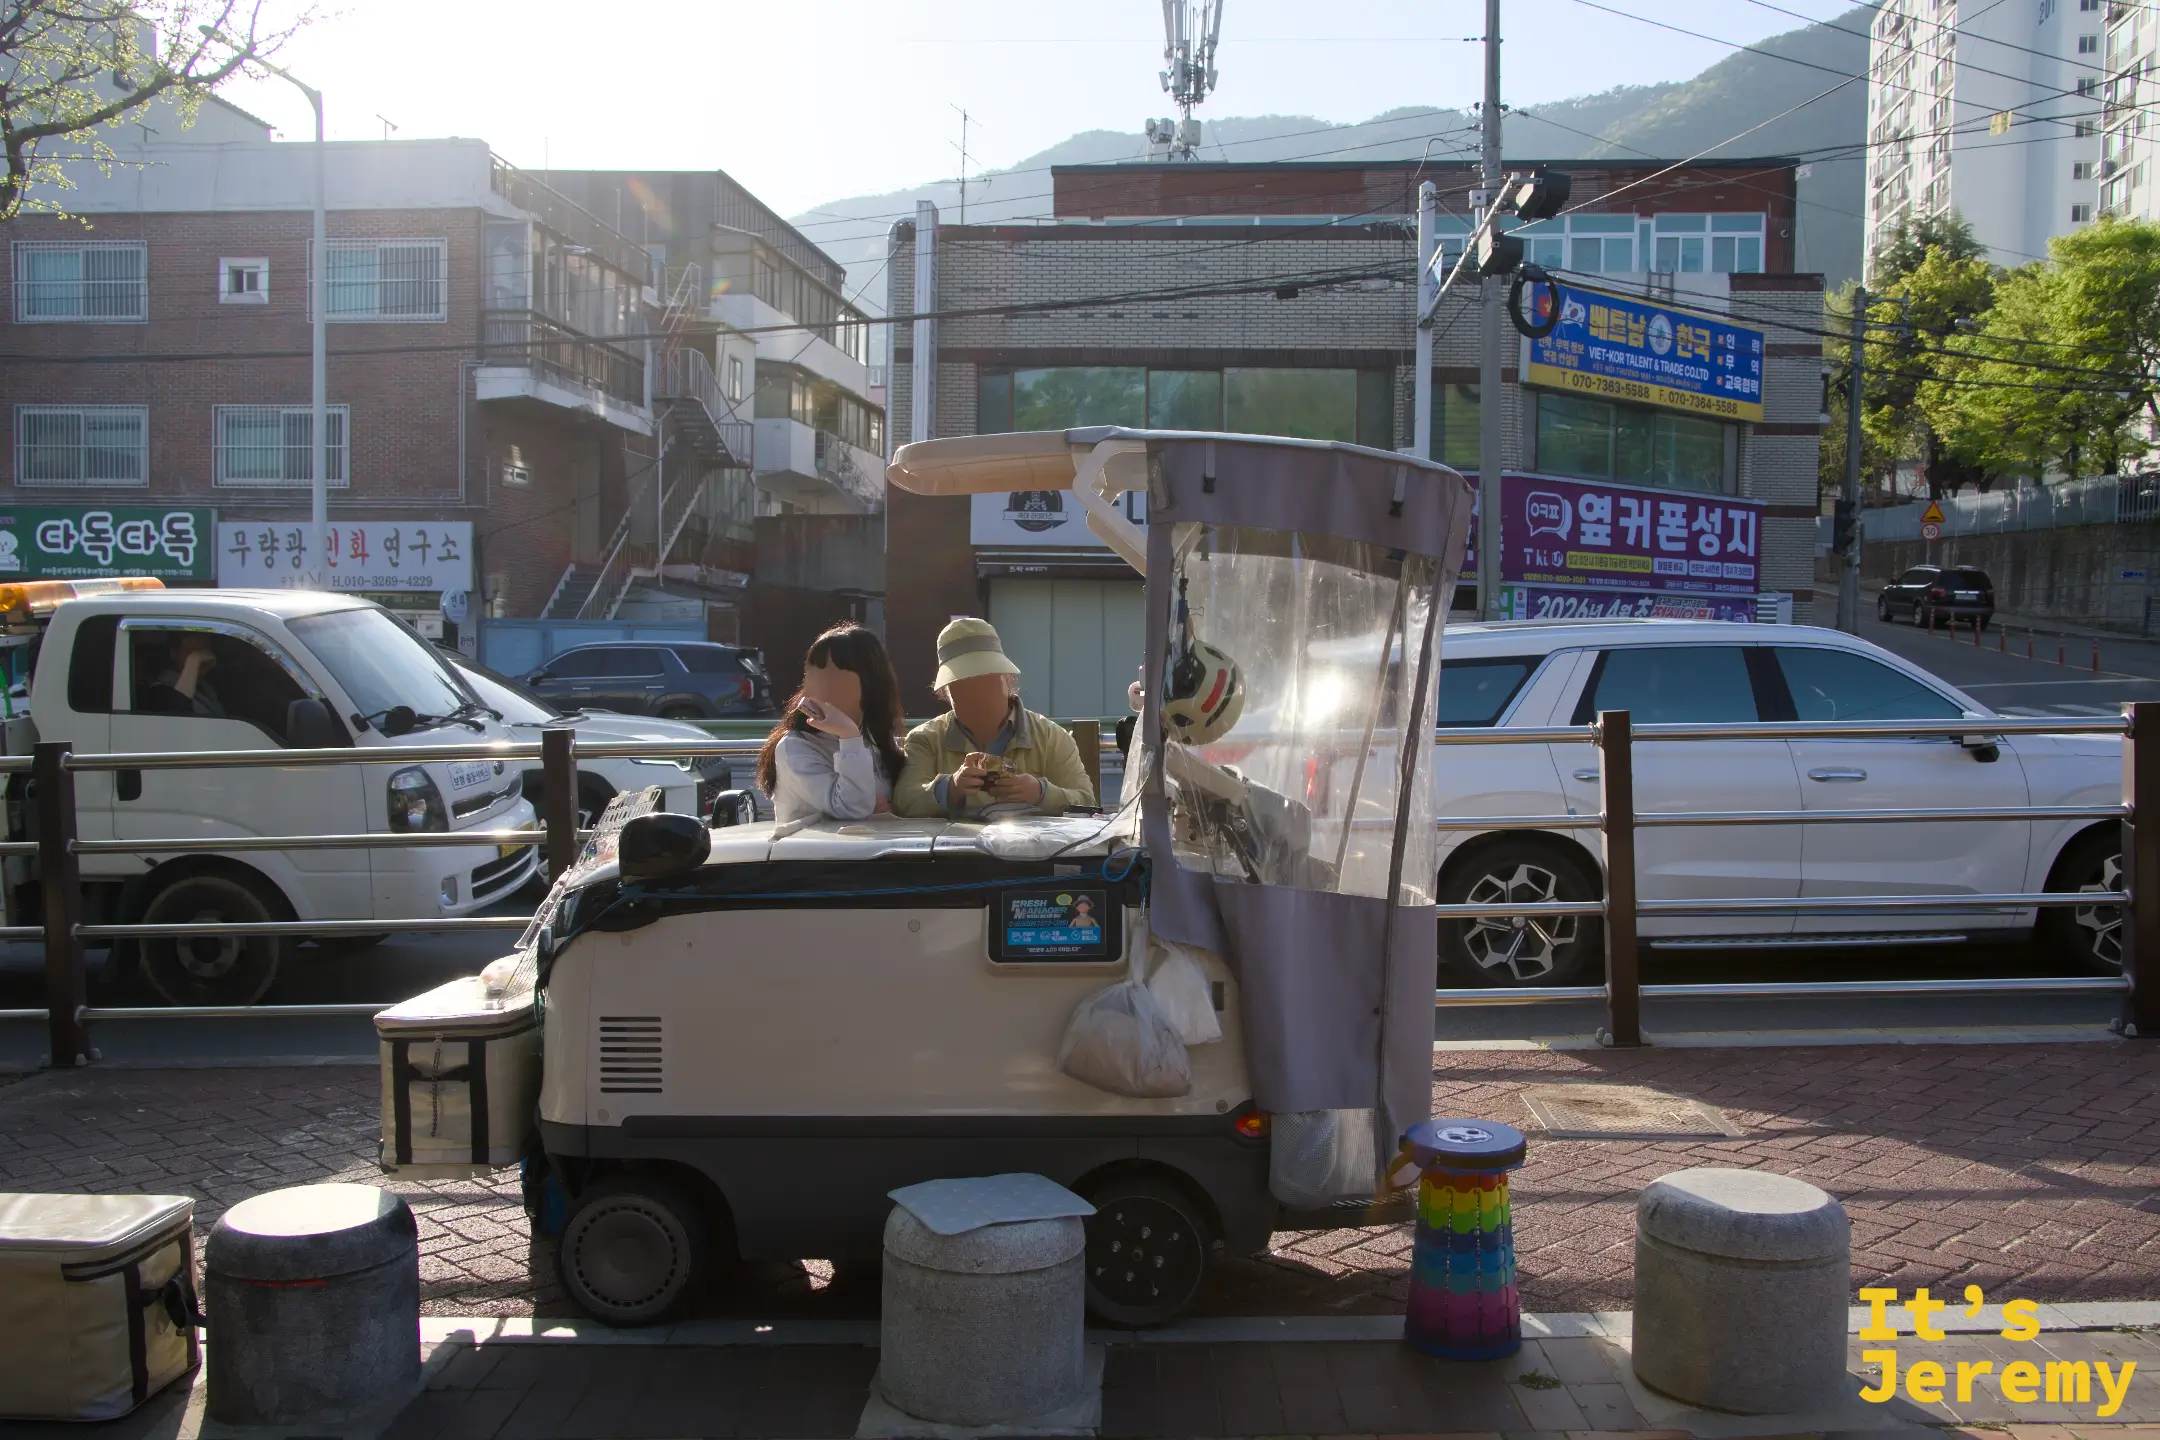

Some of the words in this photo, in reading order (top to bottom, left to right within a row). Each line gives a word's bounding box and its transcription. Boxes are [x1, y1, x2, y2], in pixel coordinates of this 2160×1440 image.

[1589, 304, 1646, 348] 베트남
[1676, 323, 1711, 363] 한국
[1588, 345, 1625, 364] VIET-KOR
[1625, 353, 1654, 371] TALENT
[1653, 359, 1660, 370] &
[1660, 360, 1684, 376] TRADE
[36, 511, 198, 566] 다독다독
[1577, 492, 1756, 557] 옆커폰성지
[1925, 527, 1936, 537] 30
[383, 527, 461, 568] 연구소
[1011, 899, 1048, 911] FRESH
